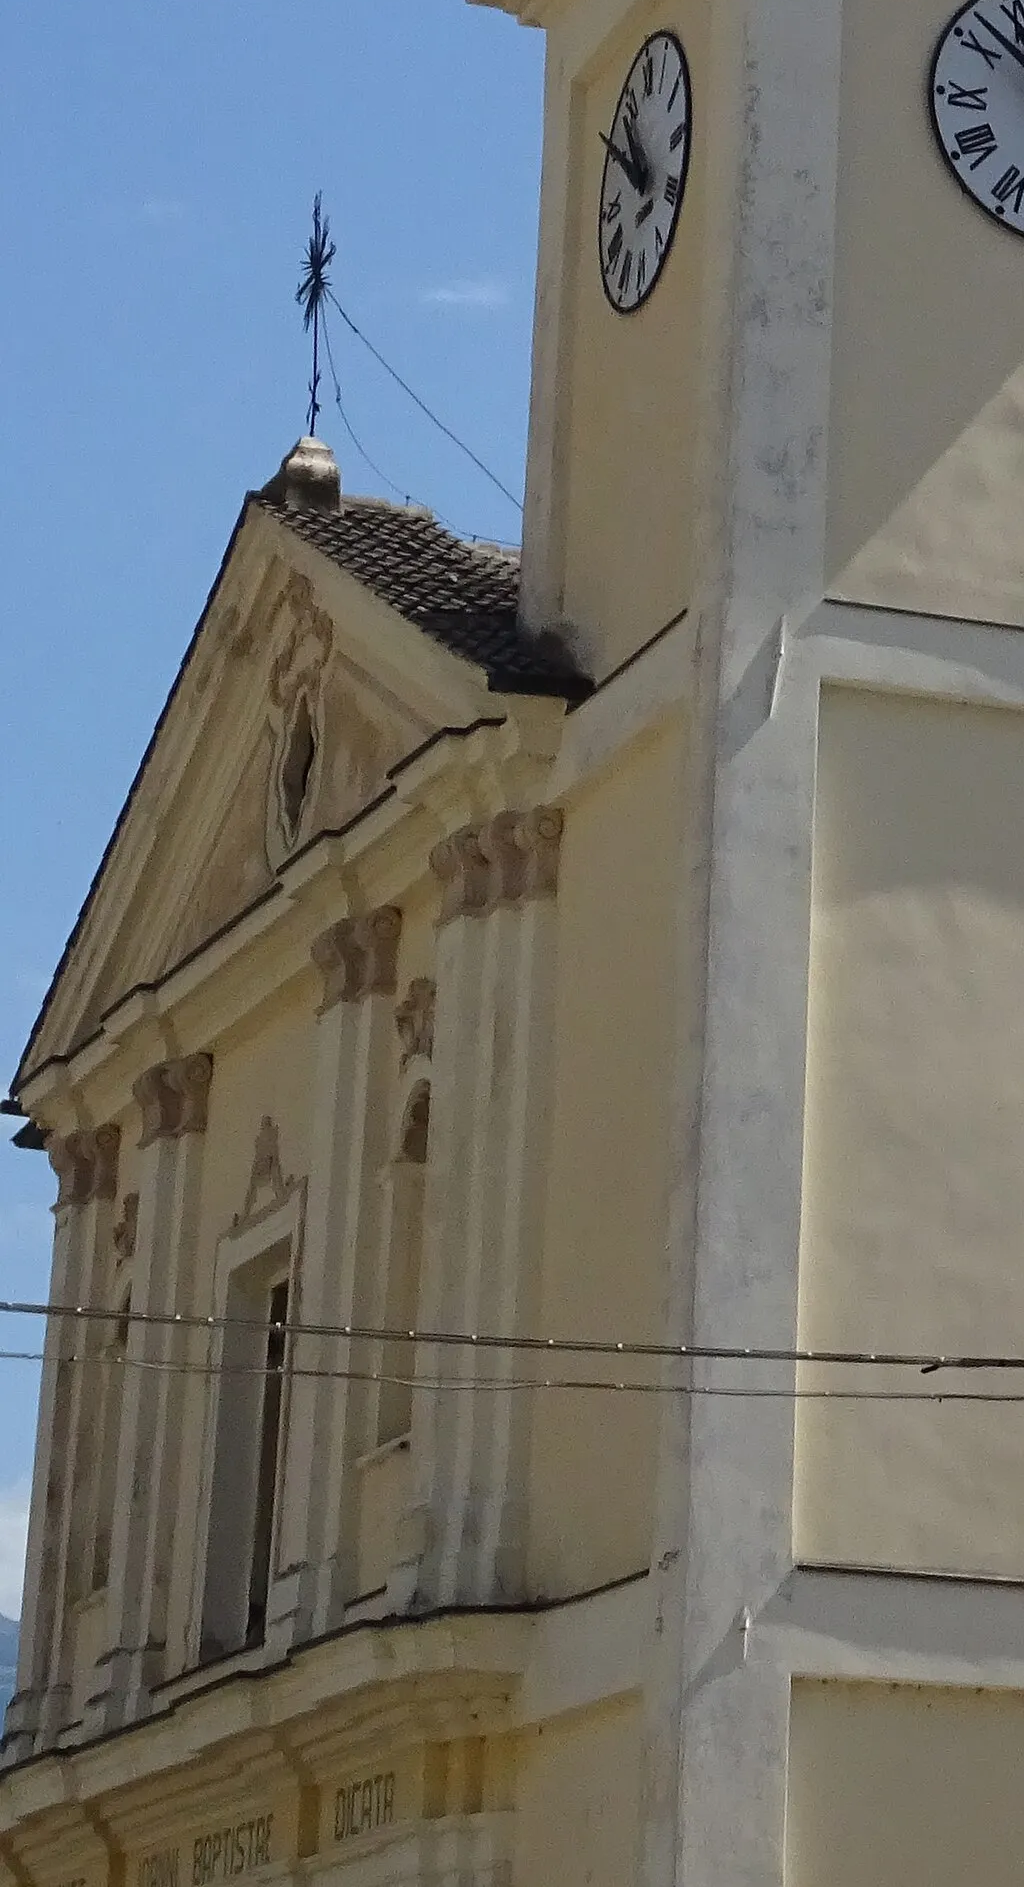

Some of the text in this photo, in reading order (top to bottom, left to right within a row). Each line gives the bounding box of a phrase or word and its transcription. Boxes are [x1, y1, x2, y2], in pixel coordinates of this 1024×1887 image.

[960, 29, 1003, 70] X
[947, 80, 988, 111] IX
[954, 123, 998, 171] VIII
[334, 1771, 395, 1841] DICATA
